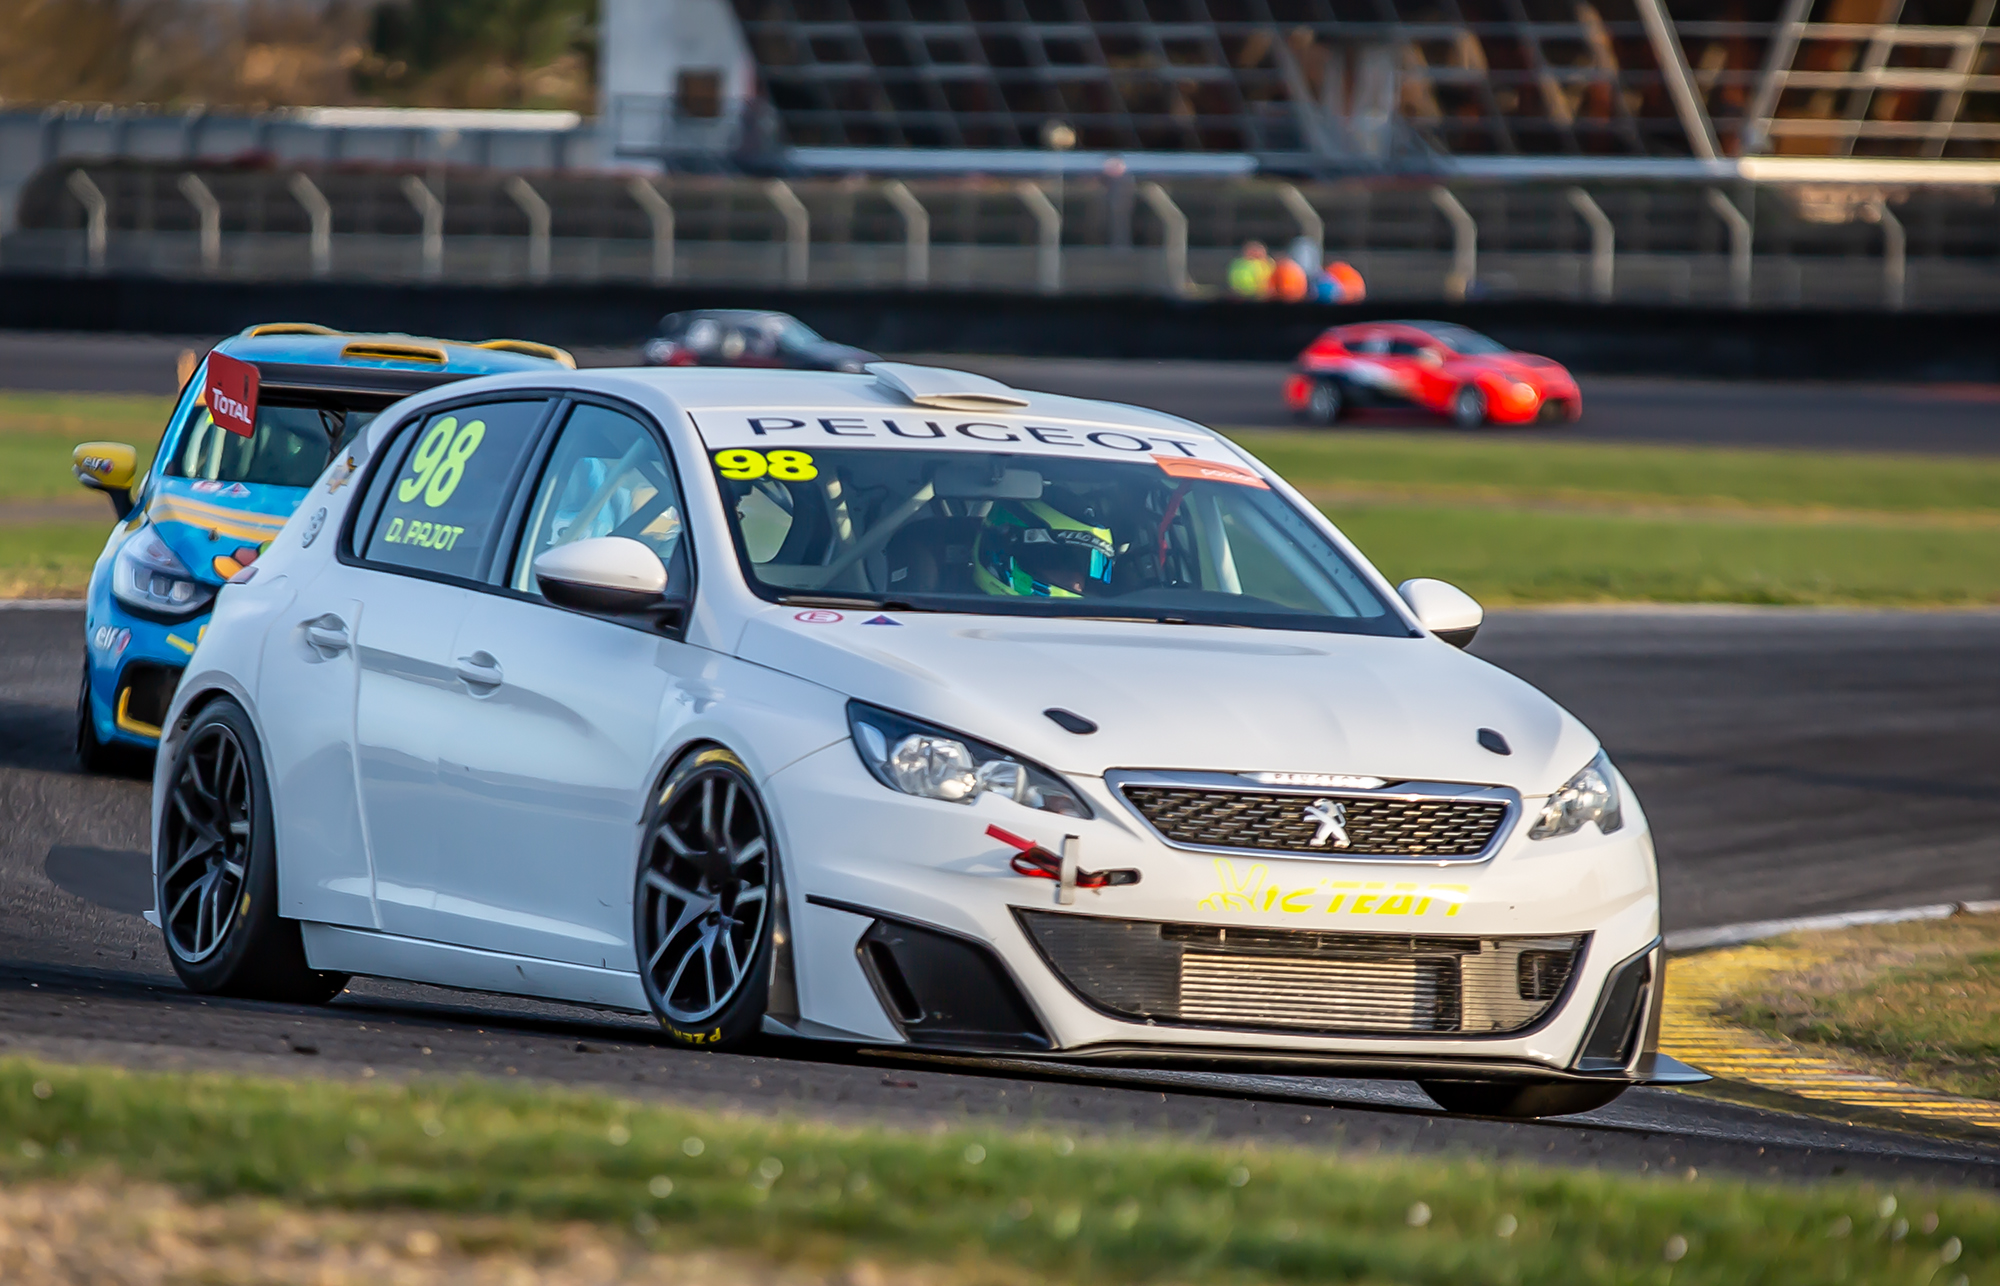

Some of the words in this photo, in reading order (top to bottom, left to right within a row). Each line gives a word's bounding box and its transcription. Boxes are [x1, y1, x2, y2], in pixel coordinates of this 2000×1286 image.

[212, 387, 252, 425] TOTAL
[746, 416, 1198, 458] PEUGEOT
[398, 416, 486, 508] 98
[714, 449, 818, 482] 98
[403, 519, 465, 551] PAJOT
